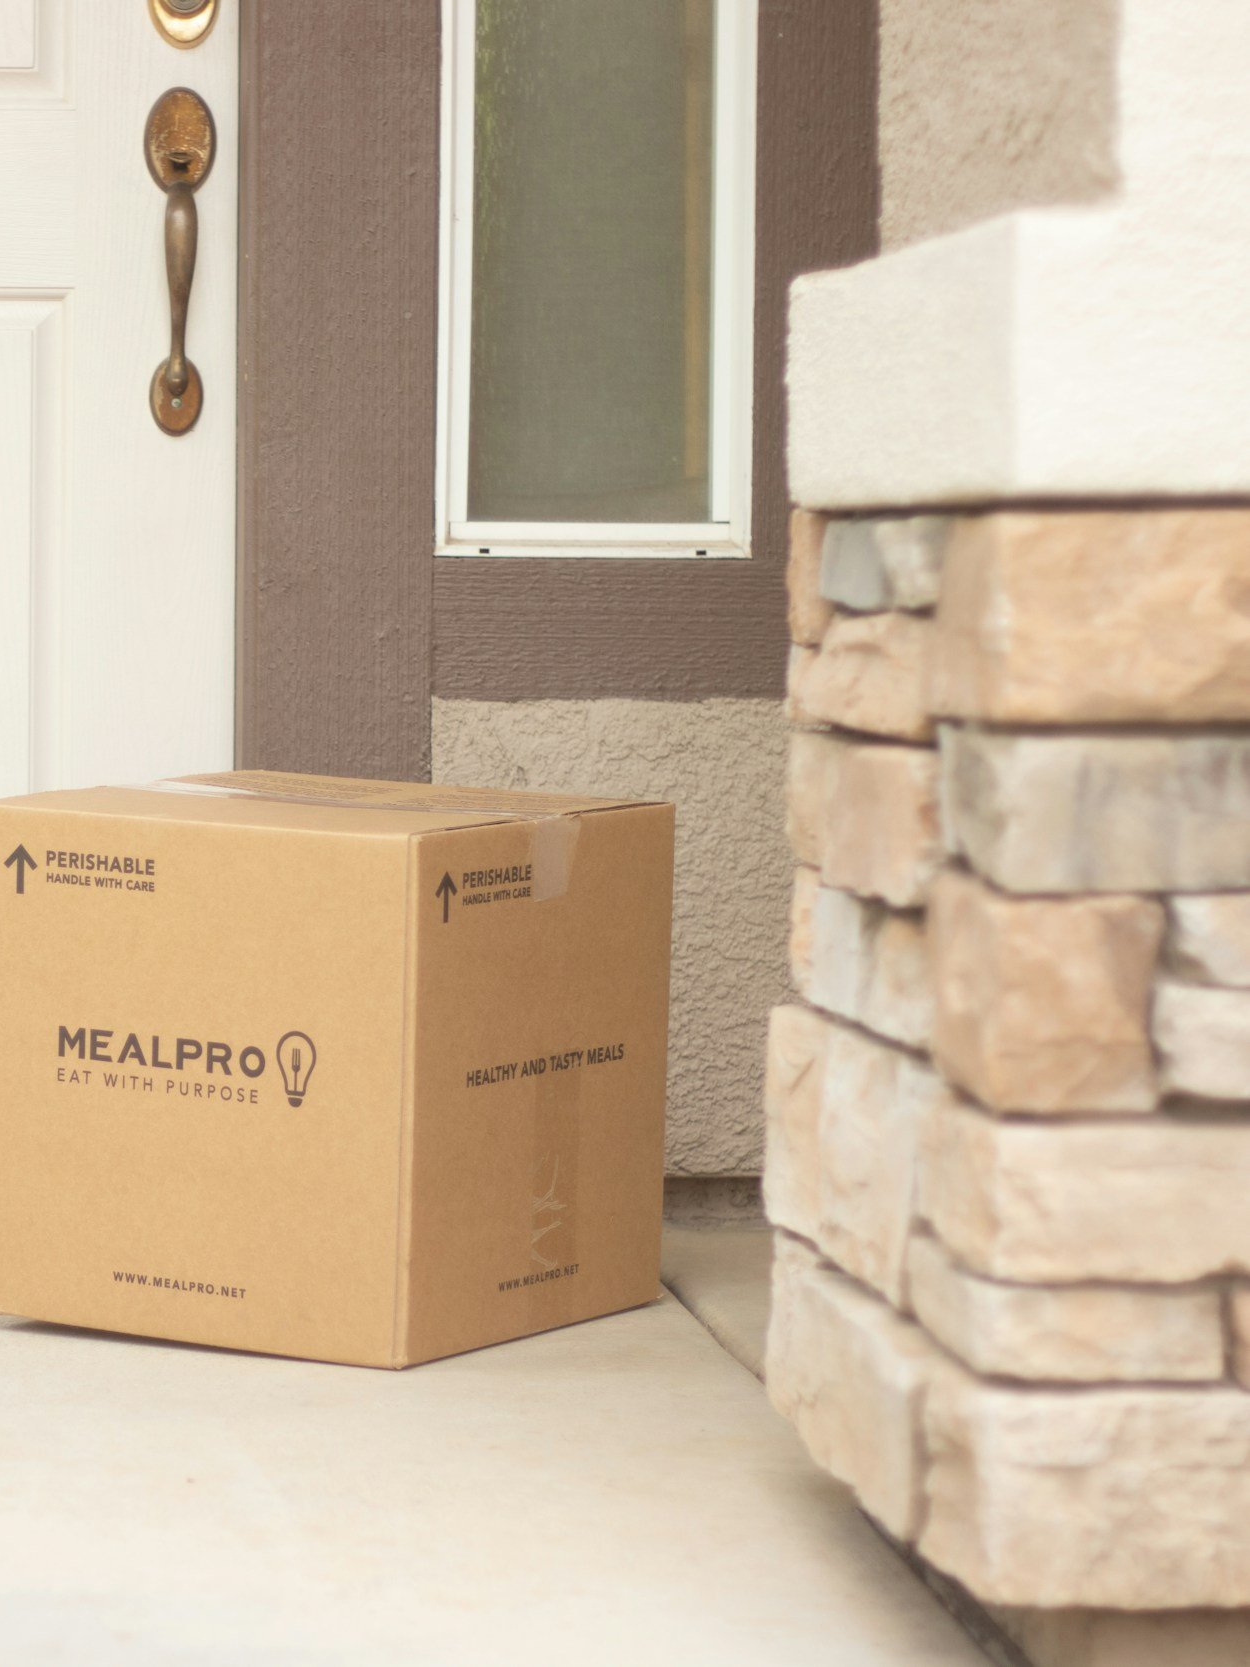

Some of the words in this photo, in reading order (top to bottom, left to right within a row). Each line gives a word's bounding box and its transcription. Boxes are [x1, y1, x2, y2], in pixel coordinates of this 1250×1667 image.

[46, 849, 156, 877] PERISHABLE
[462, 863, 532, 890] PERISHABLE
[46, 872, 92, 887] HANDLE
[94, 876, 123, 890] WITH
[126, 879, 156, 893] CARE
[462, 891, 492, 906] HANDLE
[493, 889, 511, 902] WITH
[513, 886, 531, 899] CARE
[57, 1025, 266, 1079] MEALPRO
[466, 1062, 519, 1088] HEALTHY
[521, 1057, 547, 1078] AND
[549, 1050, 584, 1072] TASTY
[587, 1043, 624, 1065] MEALS
[57, 1067, 92, 1085] EAT
[103, 1072, 153, 1092] WITH
[166, 1079, 259, 1105] PURPOSE
[112, 1271, 247, 1299] WWW.MEALPRO.NET
[498, 1263, 579, 1292] WWW.MEALPRO.NET
